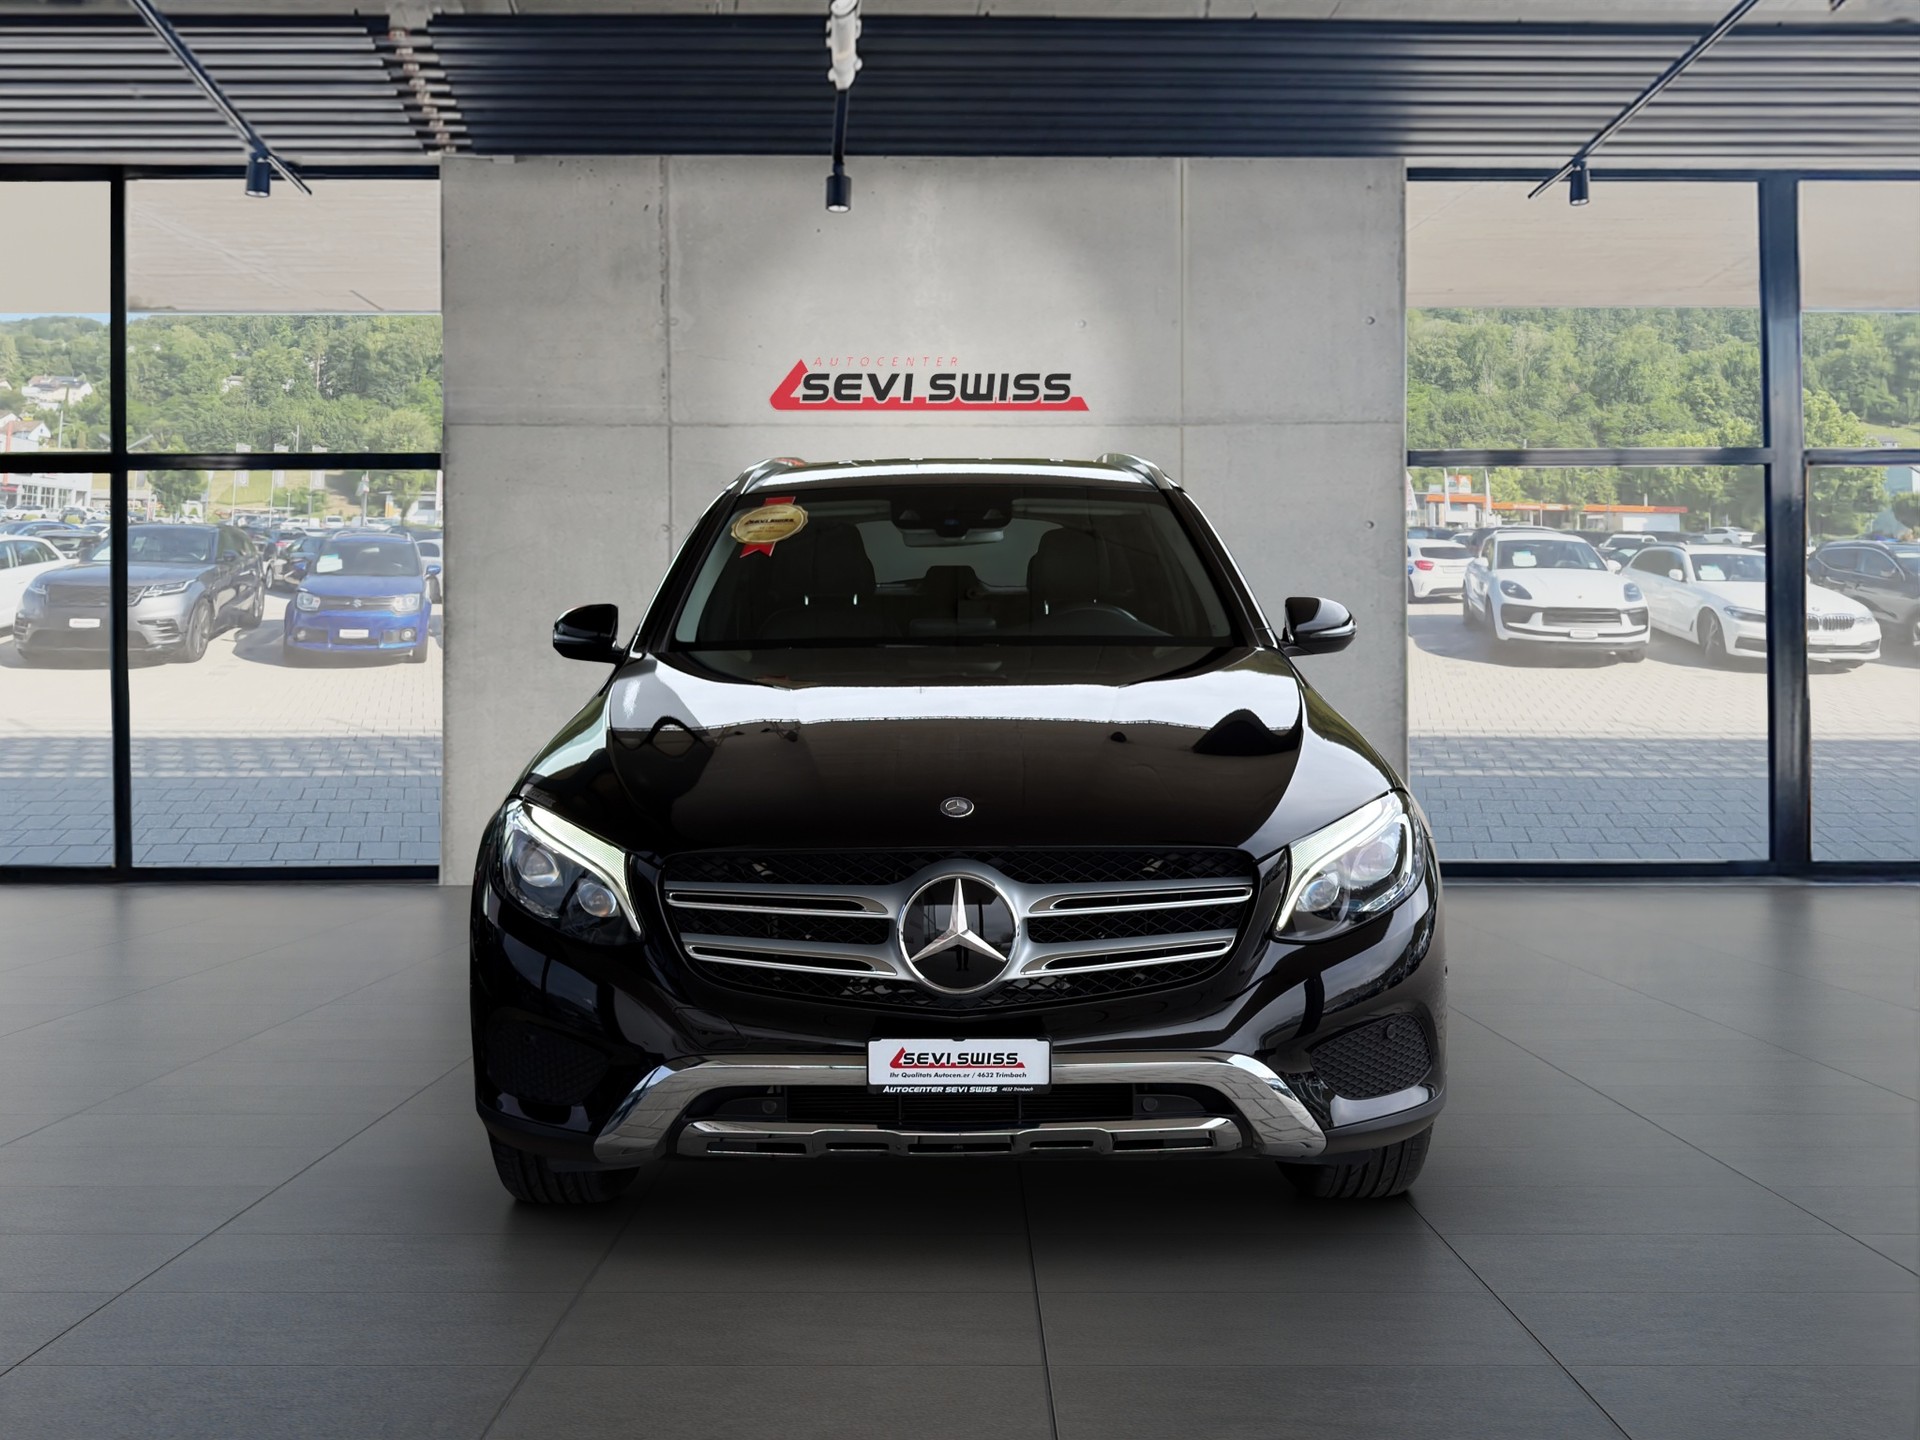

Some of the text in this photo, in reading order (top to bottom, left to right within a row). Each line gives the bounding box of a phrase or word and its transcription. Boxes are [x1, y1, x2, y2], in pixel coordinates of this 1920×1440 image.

[813, 356, 959, 367] AUTOCENTER
[801, 373, 1072, 402] SEVI SWISS
[902, 1053, 1018, 1065] SEVI SWISS
